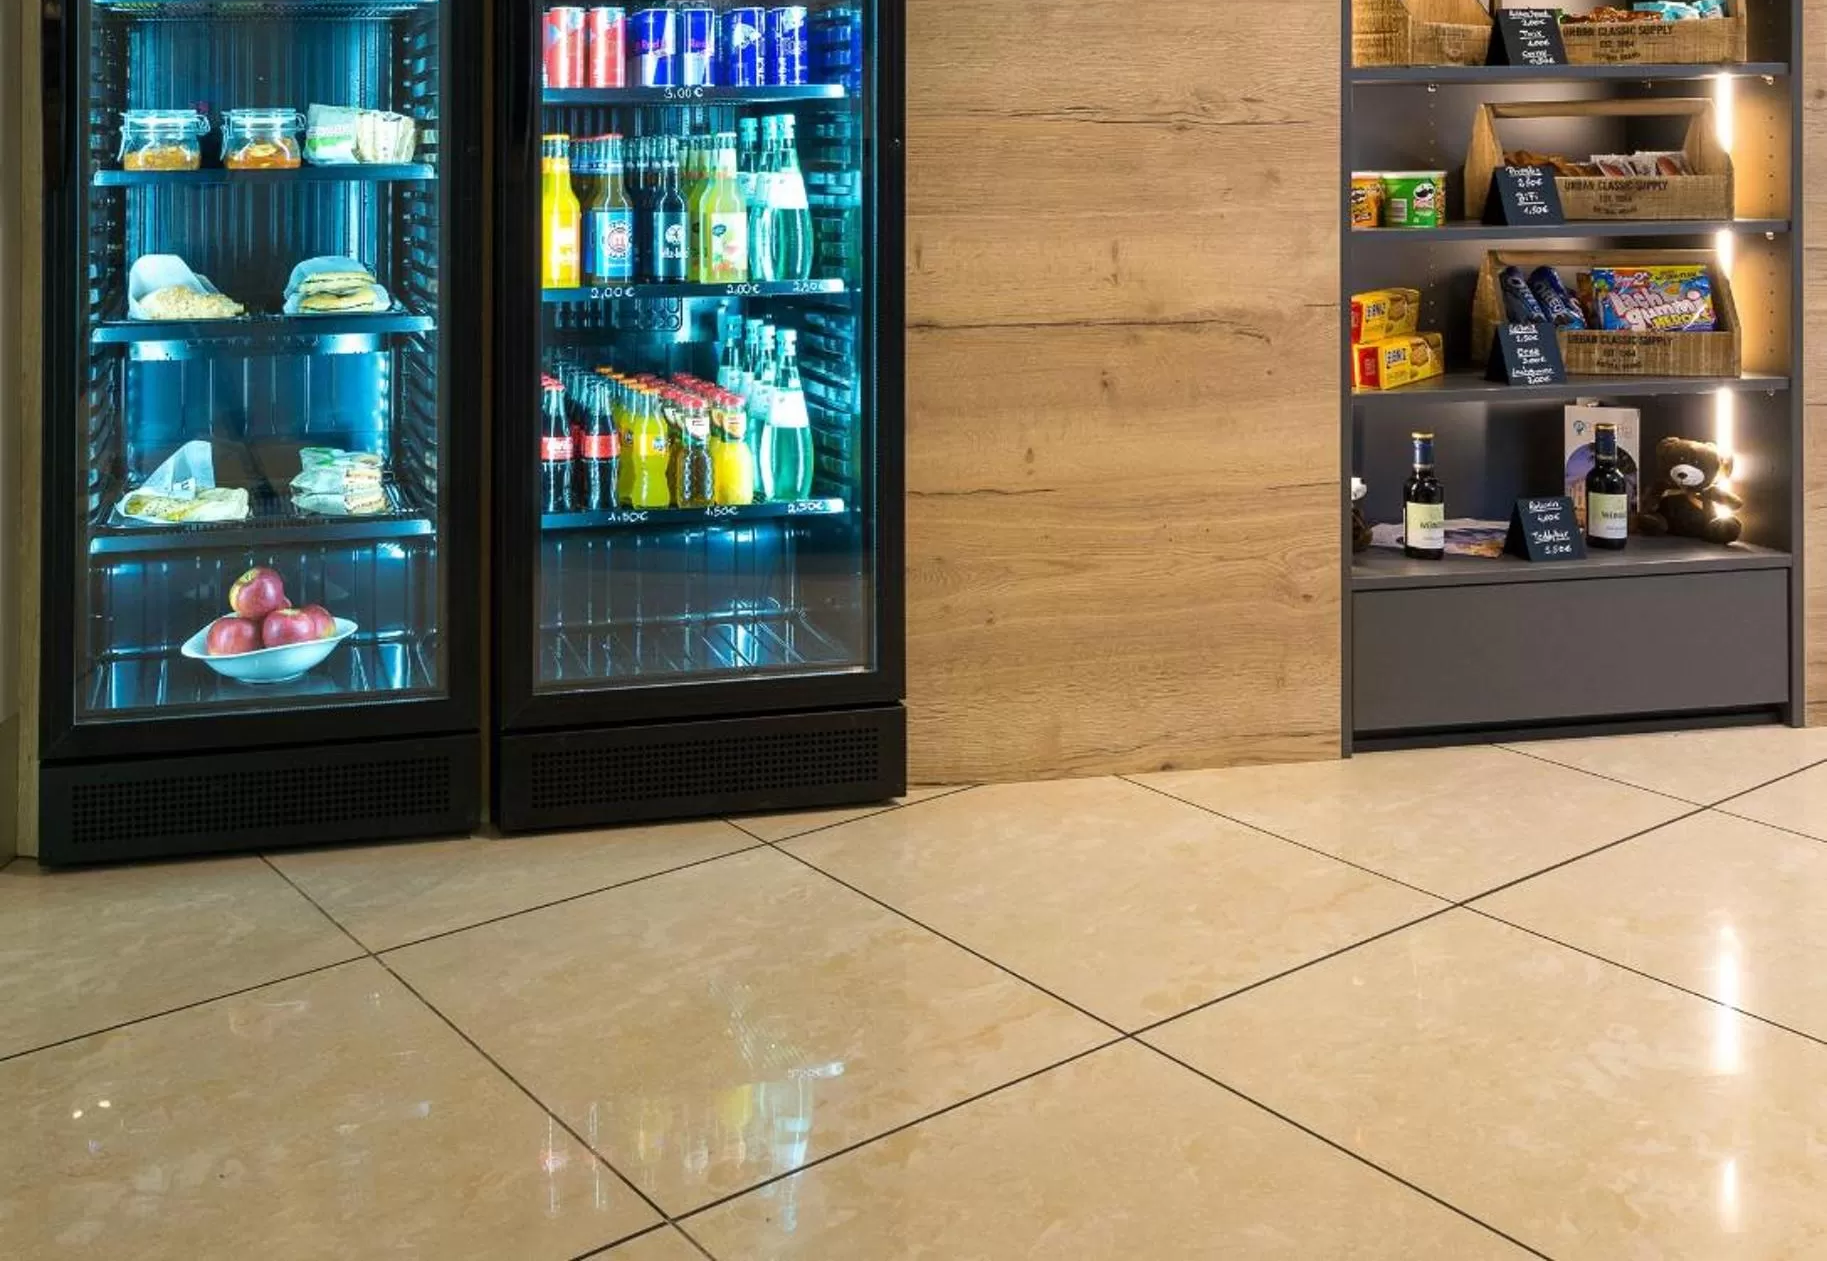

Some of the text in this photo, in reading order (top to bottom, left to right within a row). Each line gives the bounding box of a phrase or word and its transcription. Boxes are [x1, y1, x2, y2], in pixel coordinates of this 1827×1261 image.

[1598, 25, 1636, 36] CLASSIC
[1638, 24, 1673, 35] SUPPLY
[1598, 180, 1635, 191] CLASSIC
[1636, 180, 1668, 191] SUPPLY
